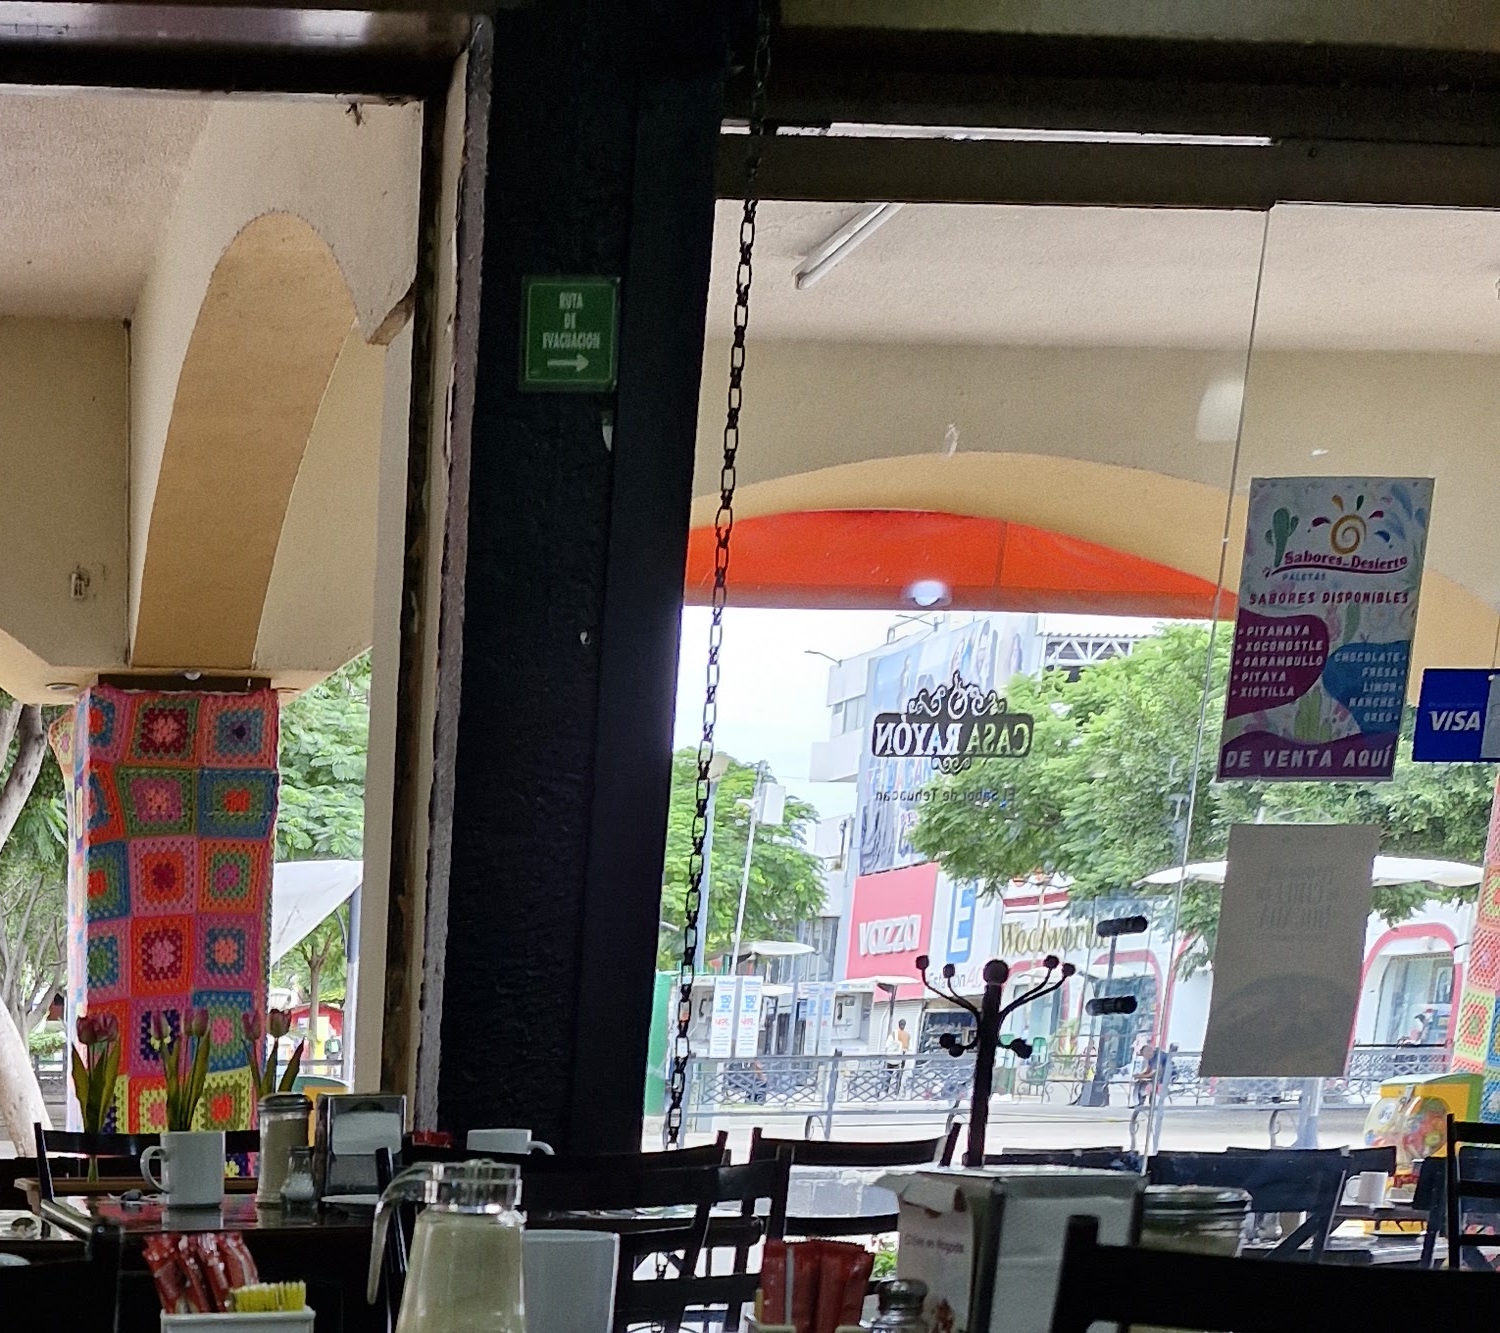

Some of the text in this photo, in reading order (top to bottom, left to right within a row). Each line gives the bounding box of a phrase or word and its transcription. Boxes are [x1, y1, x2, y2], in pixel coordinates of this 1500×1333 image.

[559, 292, 583, 309] RUTA
[564, 312, 576, 330] DE
[1284, 551, 1408, 570] Sabores Desierto
[1249, 591, 1409, 605] SABORES DISPONIBLES
[1246, 625, 1310, 637] PITAHAYA
[1244, 640, 1324, 652] XOCONOSTLE
[1243, 656, 1324, 668] GARAMBULLO
[1334, 652, 1400, 664] CHOCOLATE
[1241, 671, 1287, 683] PITAYA
[1361, 667, 1399, 678] FRESA
[1239, 686, 1295, 698] XIOTILLA
[1428, 710, 1481, 731] VISA
[1225, 744, 1393, 768] DE VENTA AQUÍ
